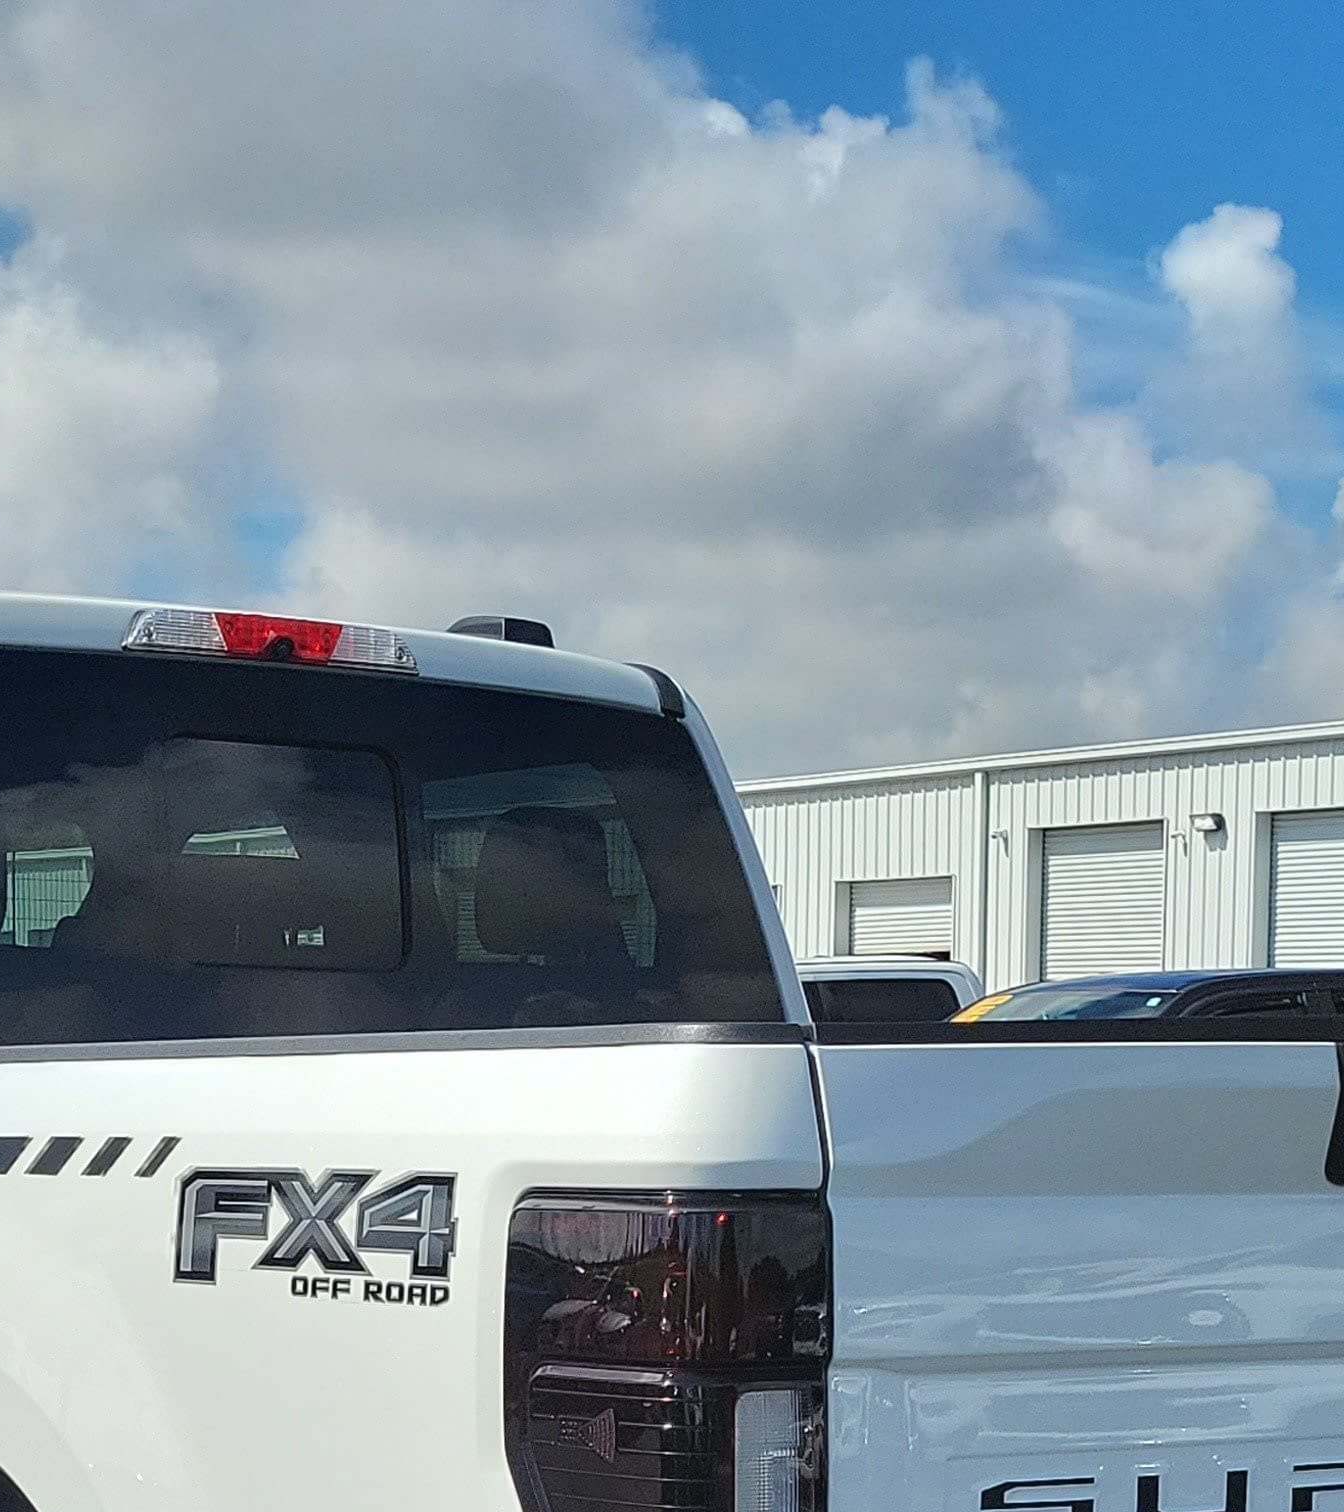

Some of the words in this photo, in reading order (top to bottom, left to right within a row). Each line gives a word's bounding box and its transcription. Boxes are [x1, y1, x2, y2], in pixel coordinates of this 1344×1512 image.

[173, 1167, 458, 1284] FX4
[290, 1275, 351, 1300] OFF
[362, 1279, 451, 1307] ROAD
